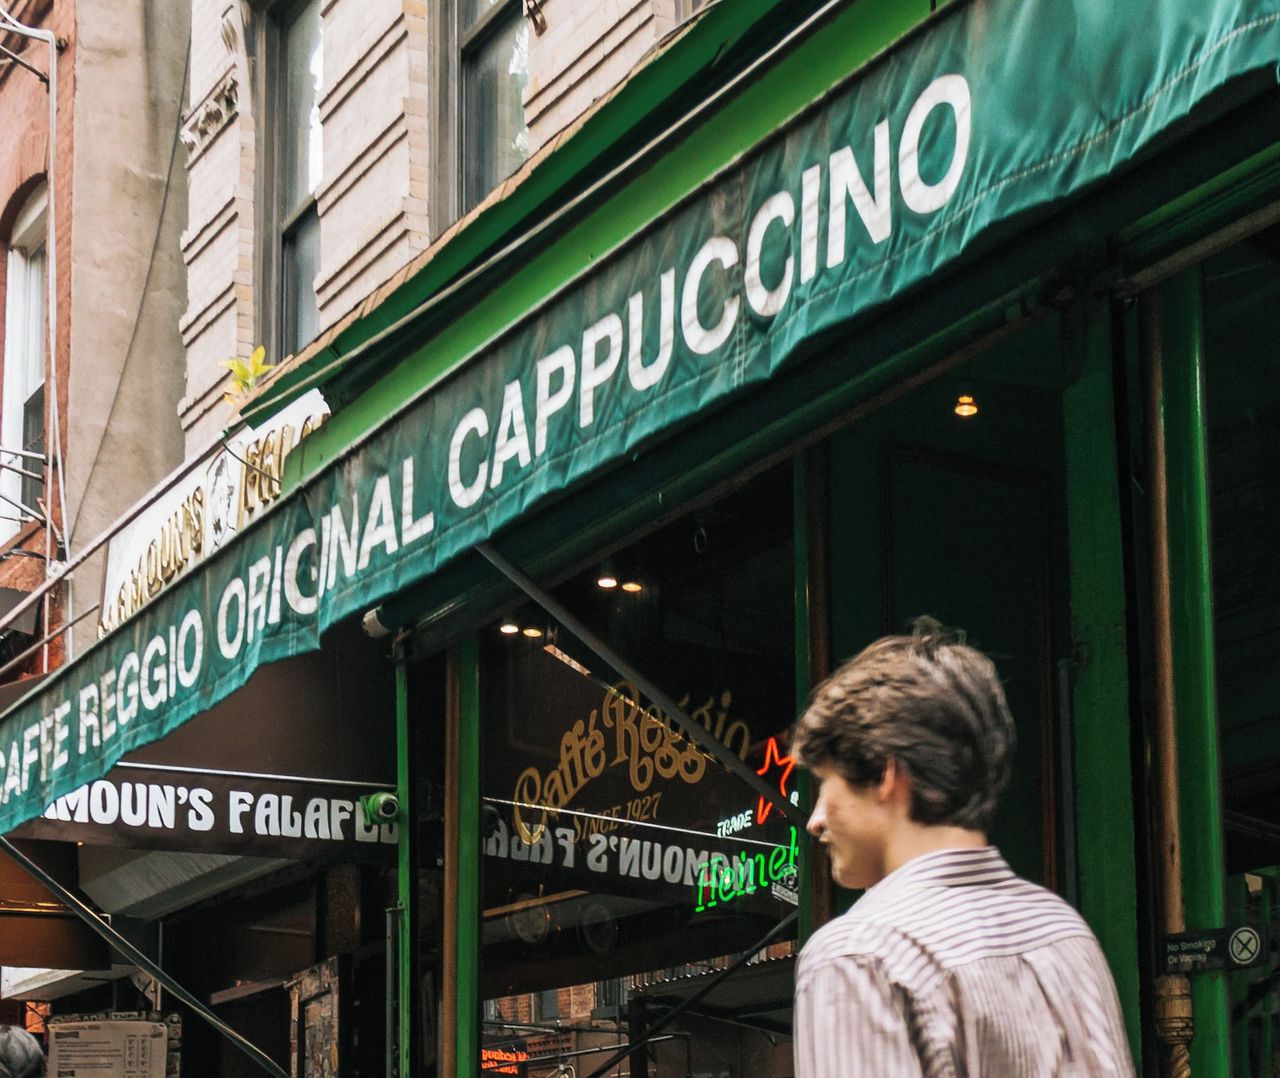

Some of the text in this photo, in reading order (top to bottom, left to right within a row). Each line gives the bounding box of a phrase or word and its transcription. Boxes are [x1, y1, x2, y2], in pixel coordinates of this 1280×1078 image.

[78, 609, 203, 756] REGGIO
[218, 458, 435, 658] ORIGINAL
[448, 73, 971, 509] CAPPUCCINO
[40, 779, 215, 832] MOUN'S
[626, 792, 662, 822] 1927
[717, 809, 753, 838] TRADE
[1166, 939, 1216, 953] No Smoking
[1167, 952, 1207, 966] Or Vaping
